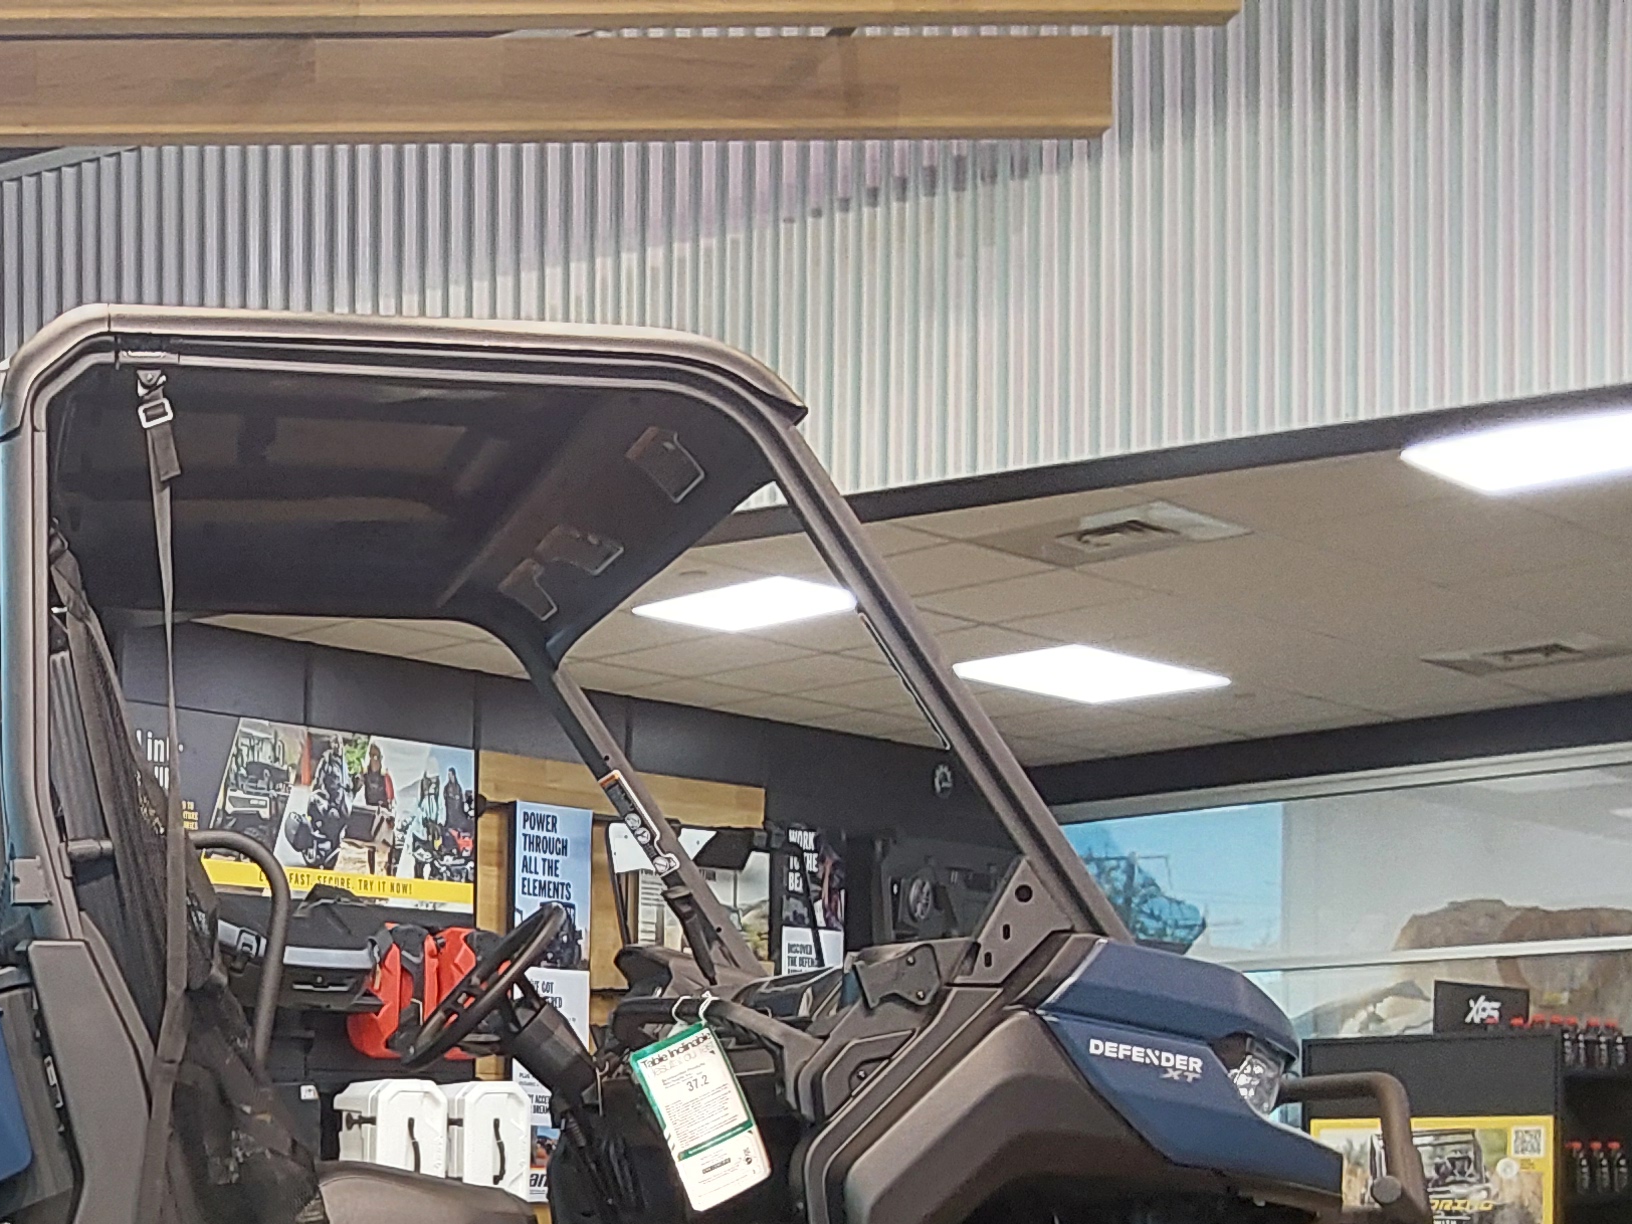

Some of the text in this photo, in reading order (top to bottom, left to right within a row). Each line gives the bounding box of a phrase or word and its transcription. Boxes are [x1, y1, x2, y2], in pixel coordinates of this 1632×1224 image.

[522, 811, 558, 833] POWER
[522, 833, 568, 857] THROUGH
[789, 829, 815, 851] WORK
[521, 855, 560, 877] ALL THE
[289, 872, 312, 886] FAST.
[358, 879, 373, 892] TRY
[378, 881, 385, 892] IT
[390, 883, 412, 895] NOW!
[521, 877, 571, 901] ELEMENTS
[1465, 995, 1501, 1024] XPS
[1088, 1038, 1203, 1073] DEFENDER
[686, 1074, 709, 1091] 37.2
[1160, 1069, 1202, 1083] XT
